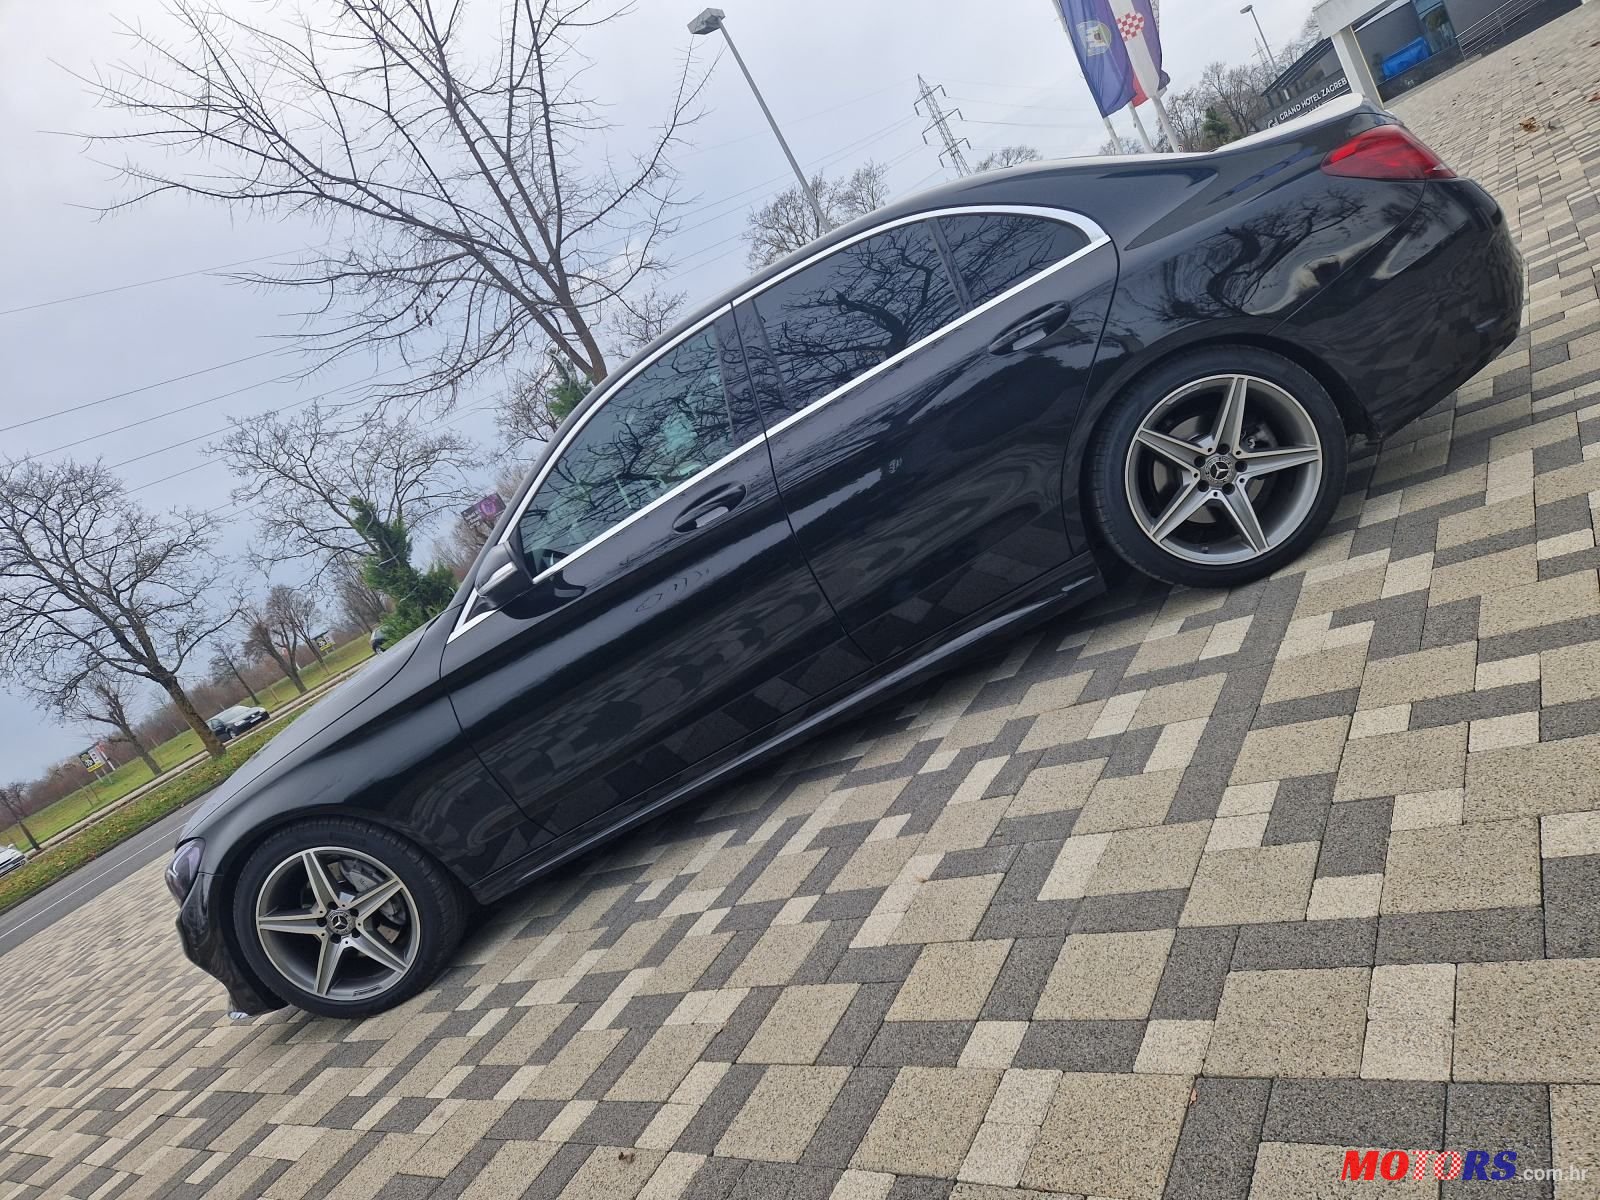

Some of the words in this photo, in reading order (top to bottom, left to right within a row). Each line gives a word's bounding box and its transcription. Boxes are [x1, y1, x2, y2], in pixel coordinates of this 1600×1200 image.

[1279, 104, 1301, 120] GRAND
[1301, 93, 1321, 109] HOTEL
[1321, 78, 1348, 97] ZAGREB
